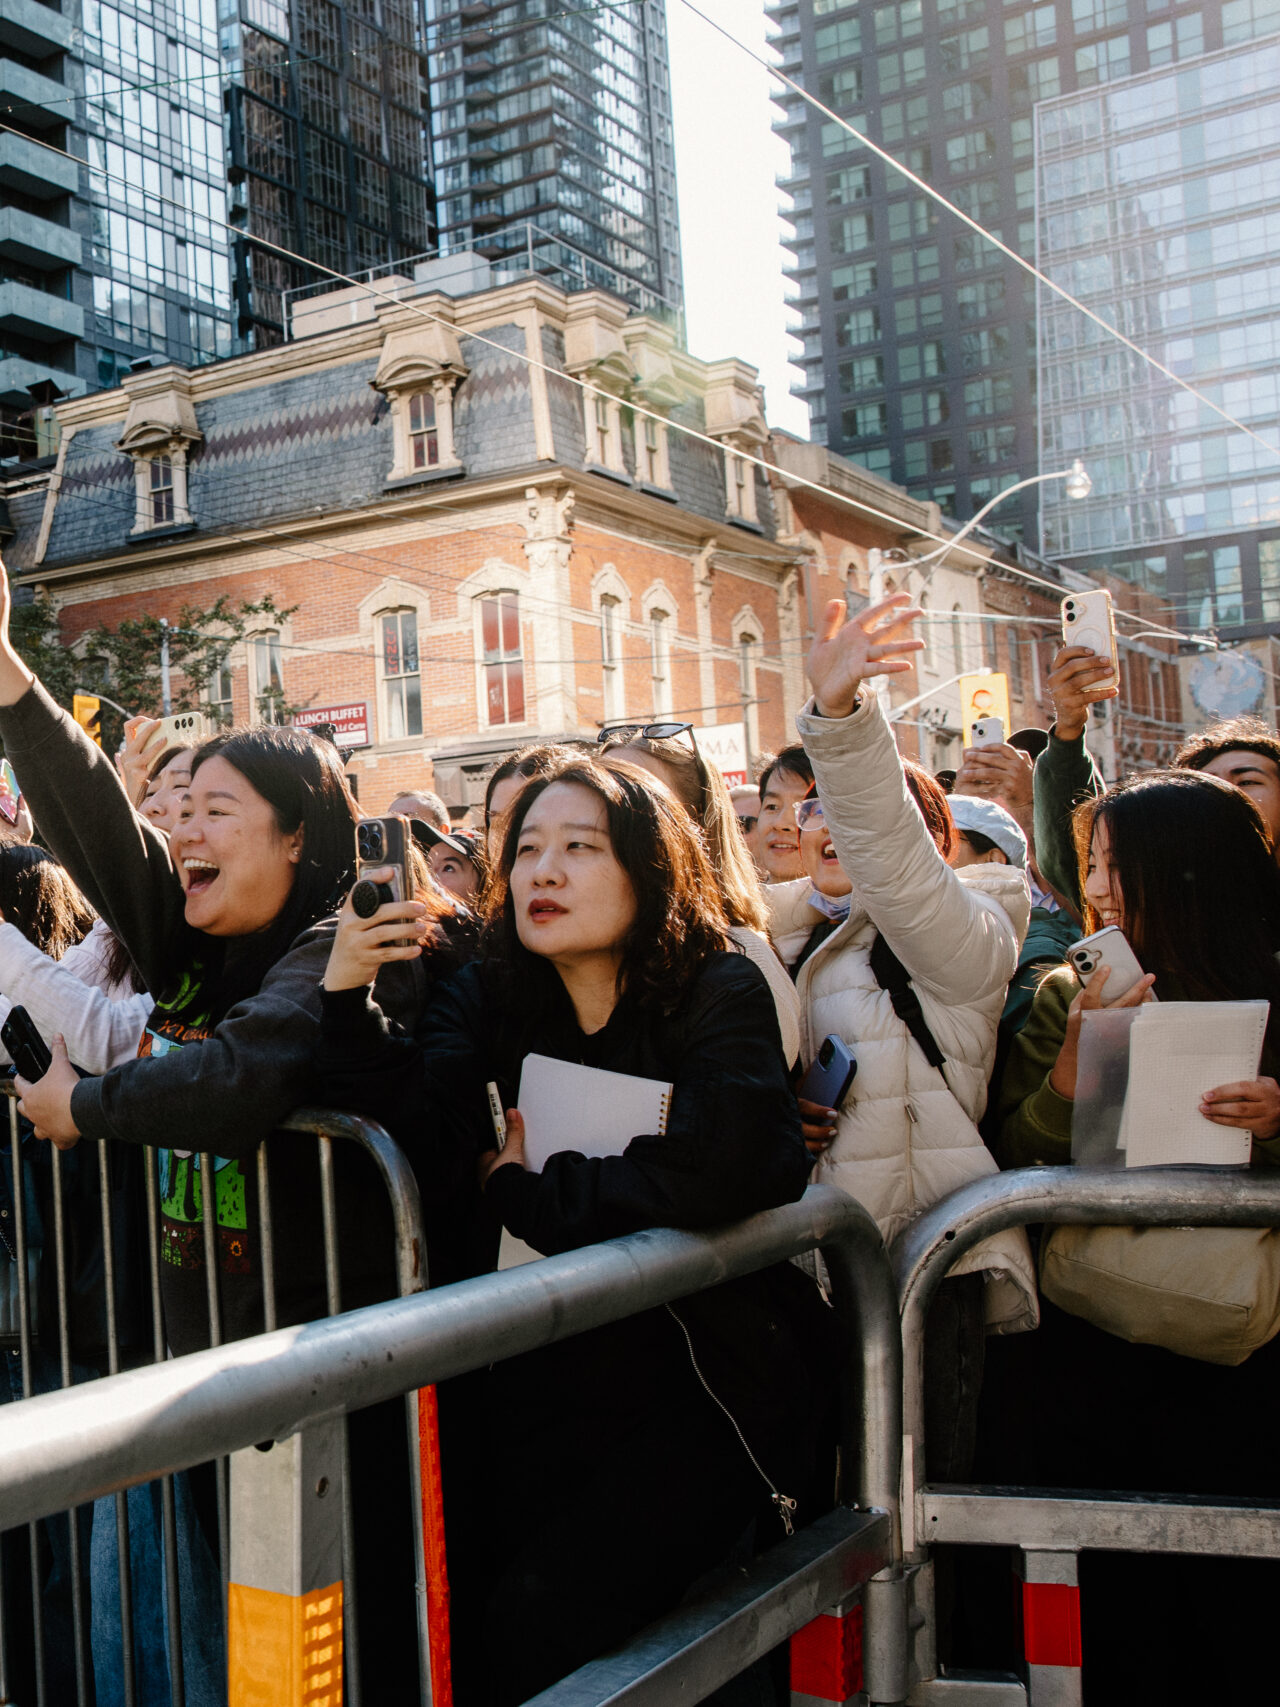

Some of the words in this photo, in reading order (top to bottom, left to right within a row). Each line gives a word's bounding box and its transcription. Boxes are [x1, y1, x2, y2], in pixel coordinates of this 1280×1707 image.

[385, 626, 399, 674] LUNCH
[295, 712, 329, 725] LUNCH
[330, 706, 364, 720] BUFFET
[705, 738, 739, 755] MA
[723, 774, 743, 788] AN
